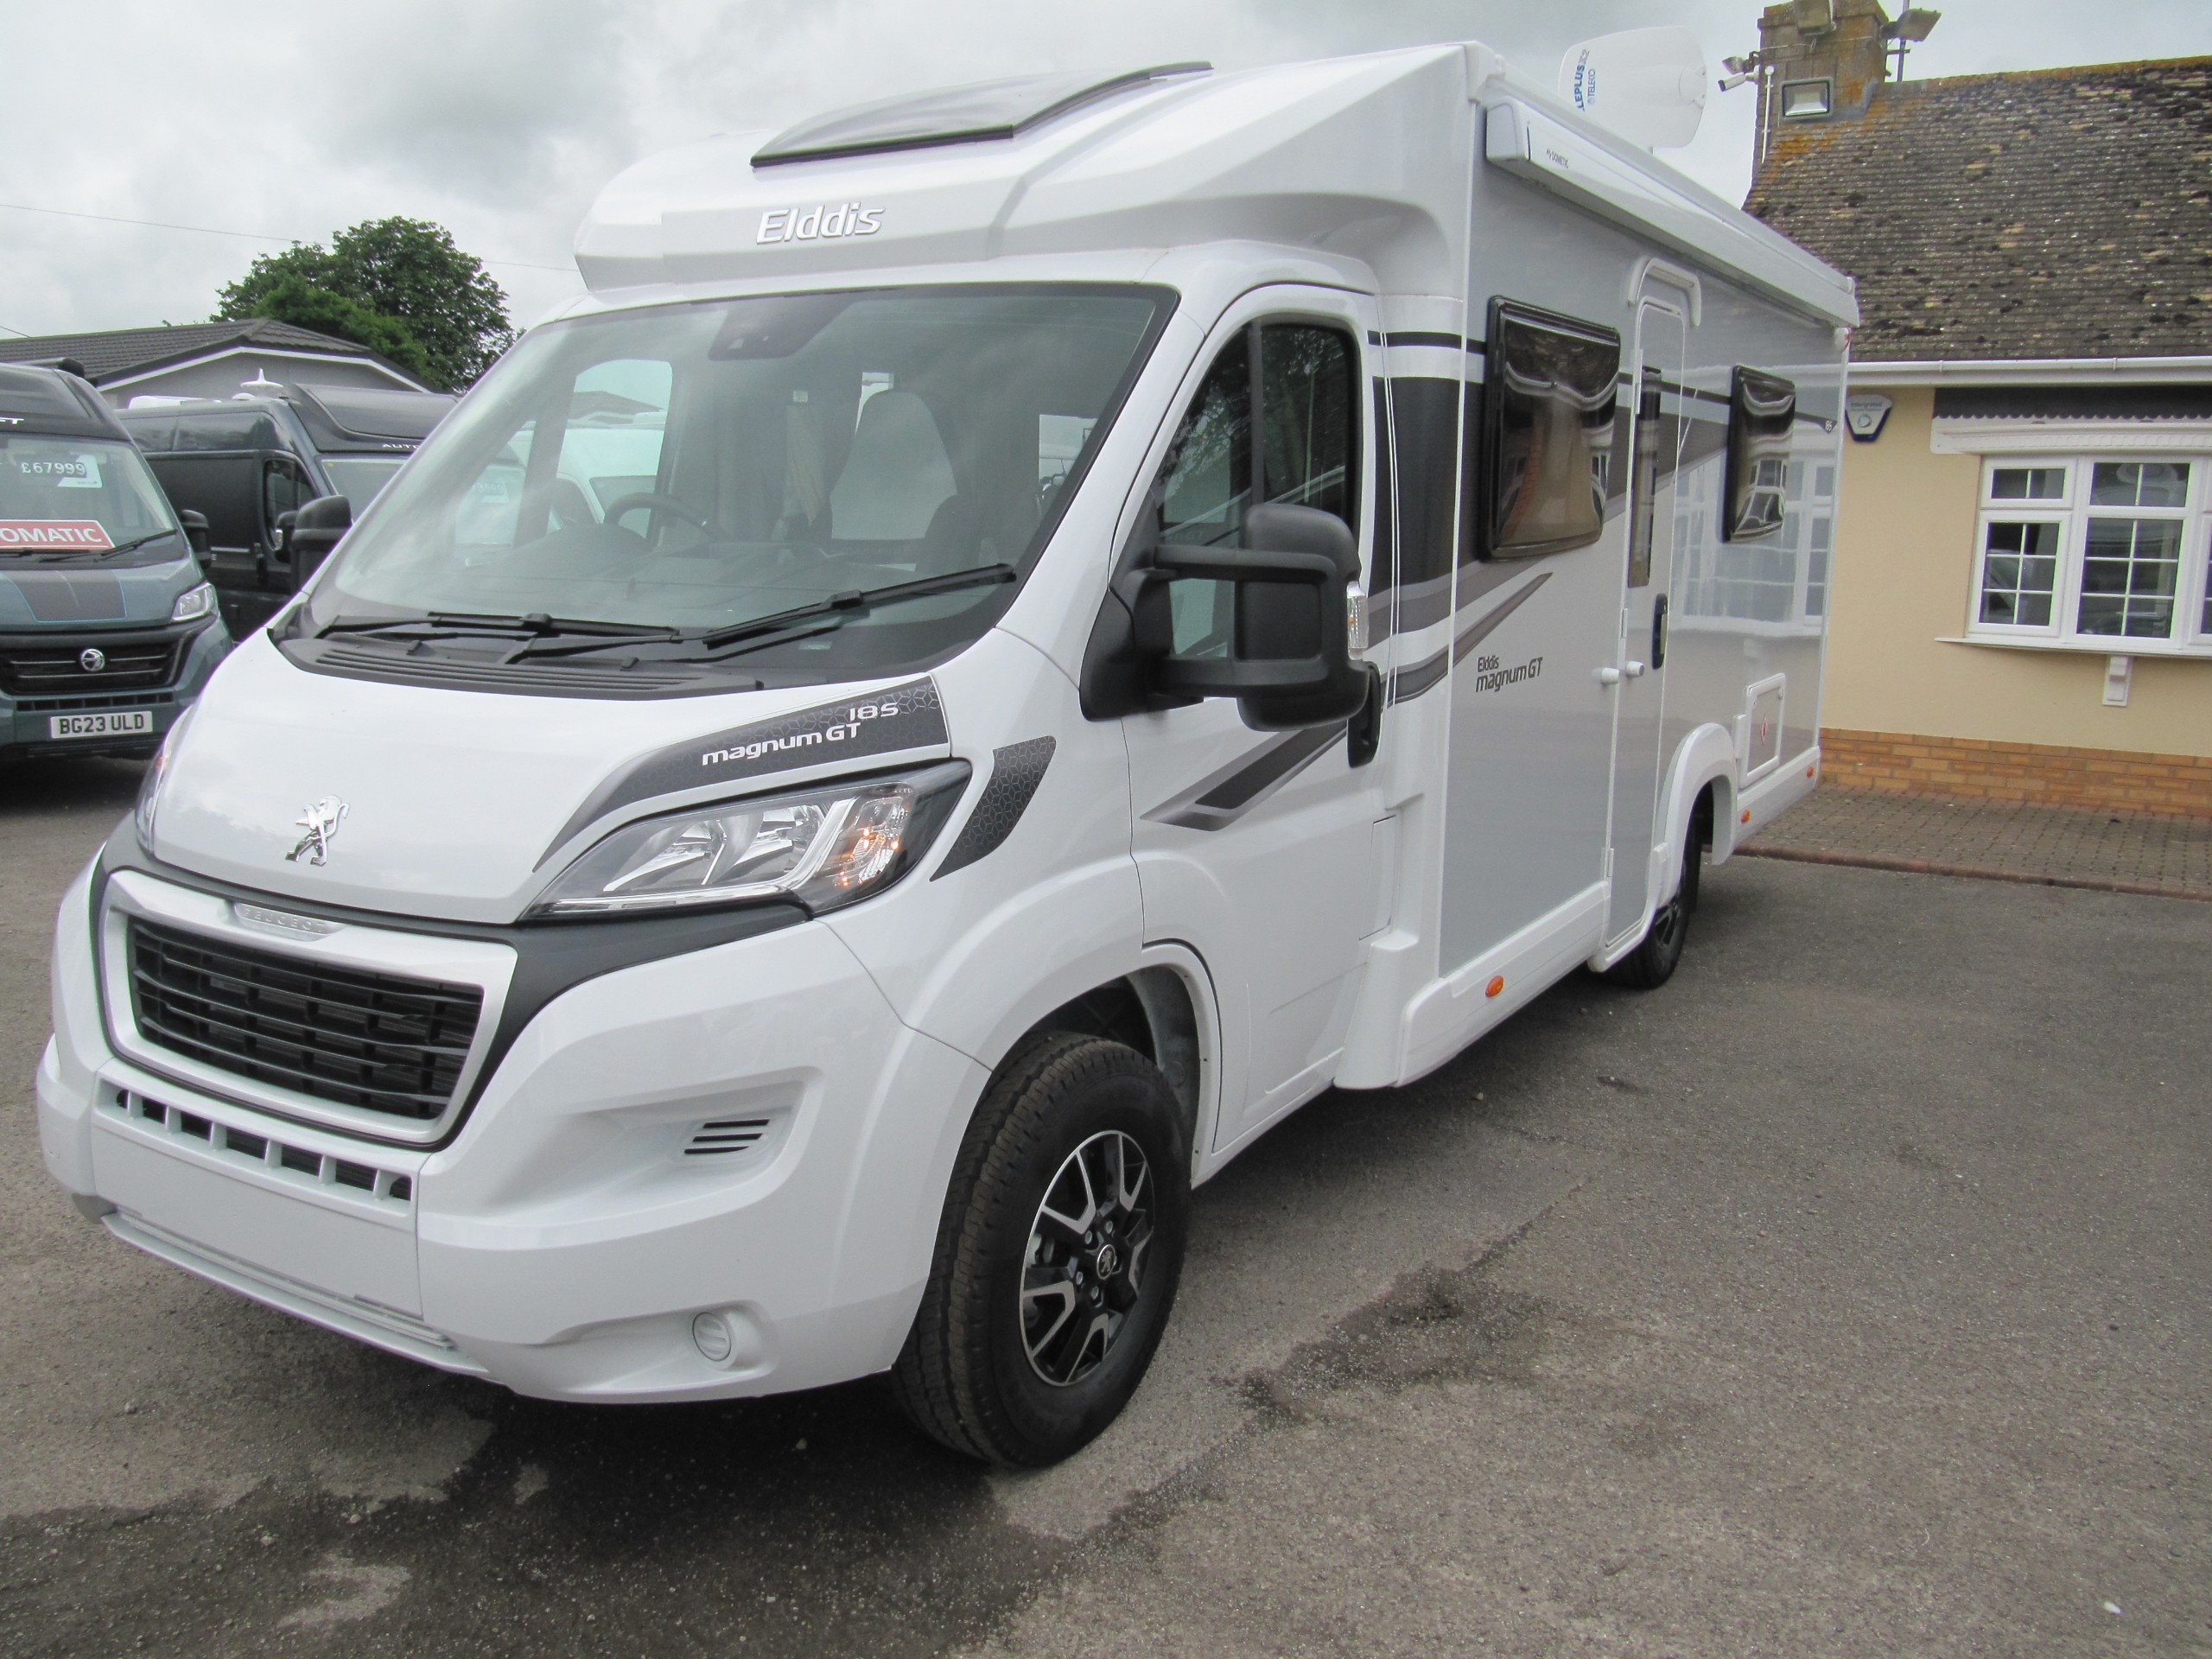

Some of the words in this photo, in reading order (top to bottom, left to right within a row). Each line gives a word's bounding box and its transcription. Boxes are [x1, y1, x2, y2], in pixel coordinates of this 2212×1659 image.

[1573, 64, 1586, 111] LEPLUS
[757, 201, 887, 245] Elddis
[21, 461, 87, 475] £67999
[1478, 655, 1500, 673] Elddis
[60, 716, 106, 734] BG23
[111, 714, 144, 731] ULD
[702, 732, 823, 766] magnum
[825, 722, 861, 741] GT
